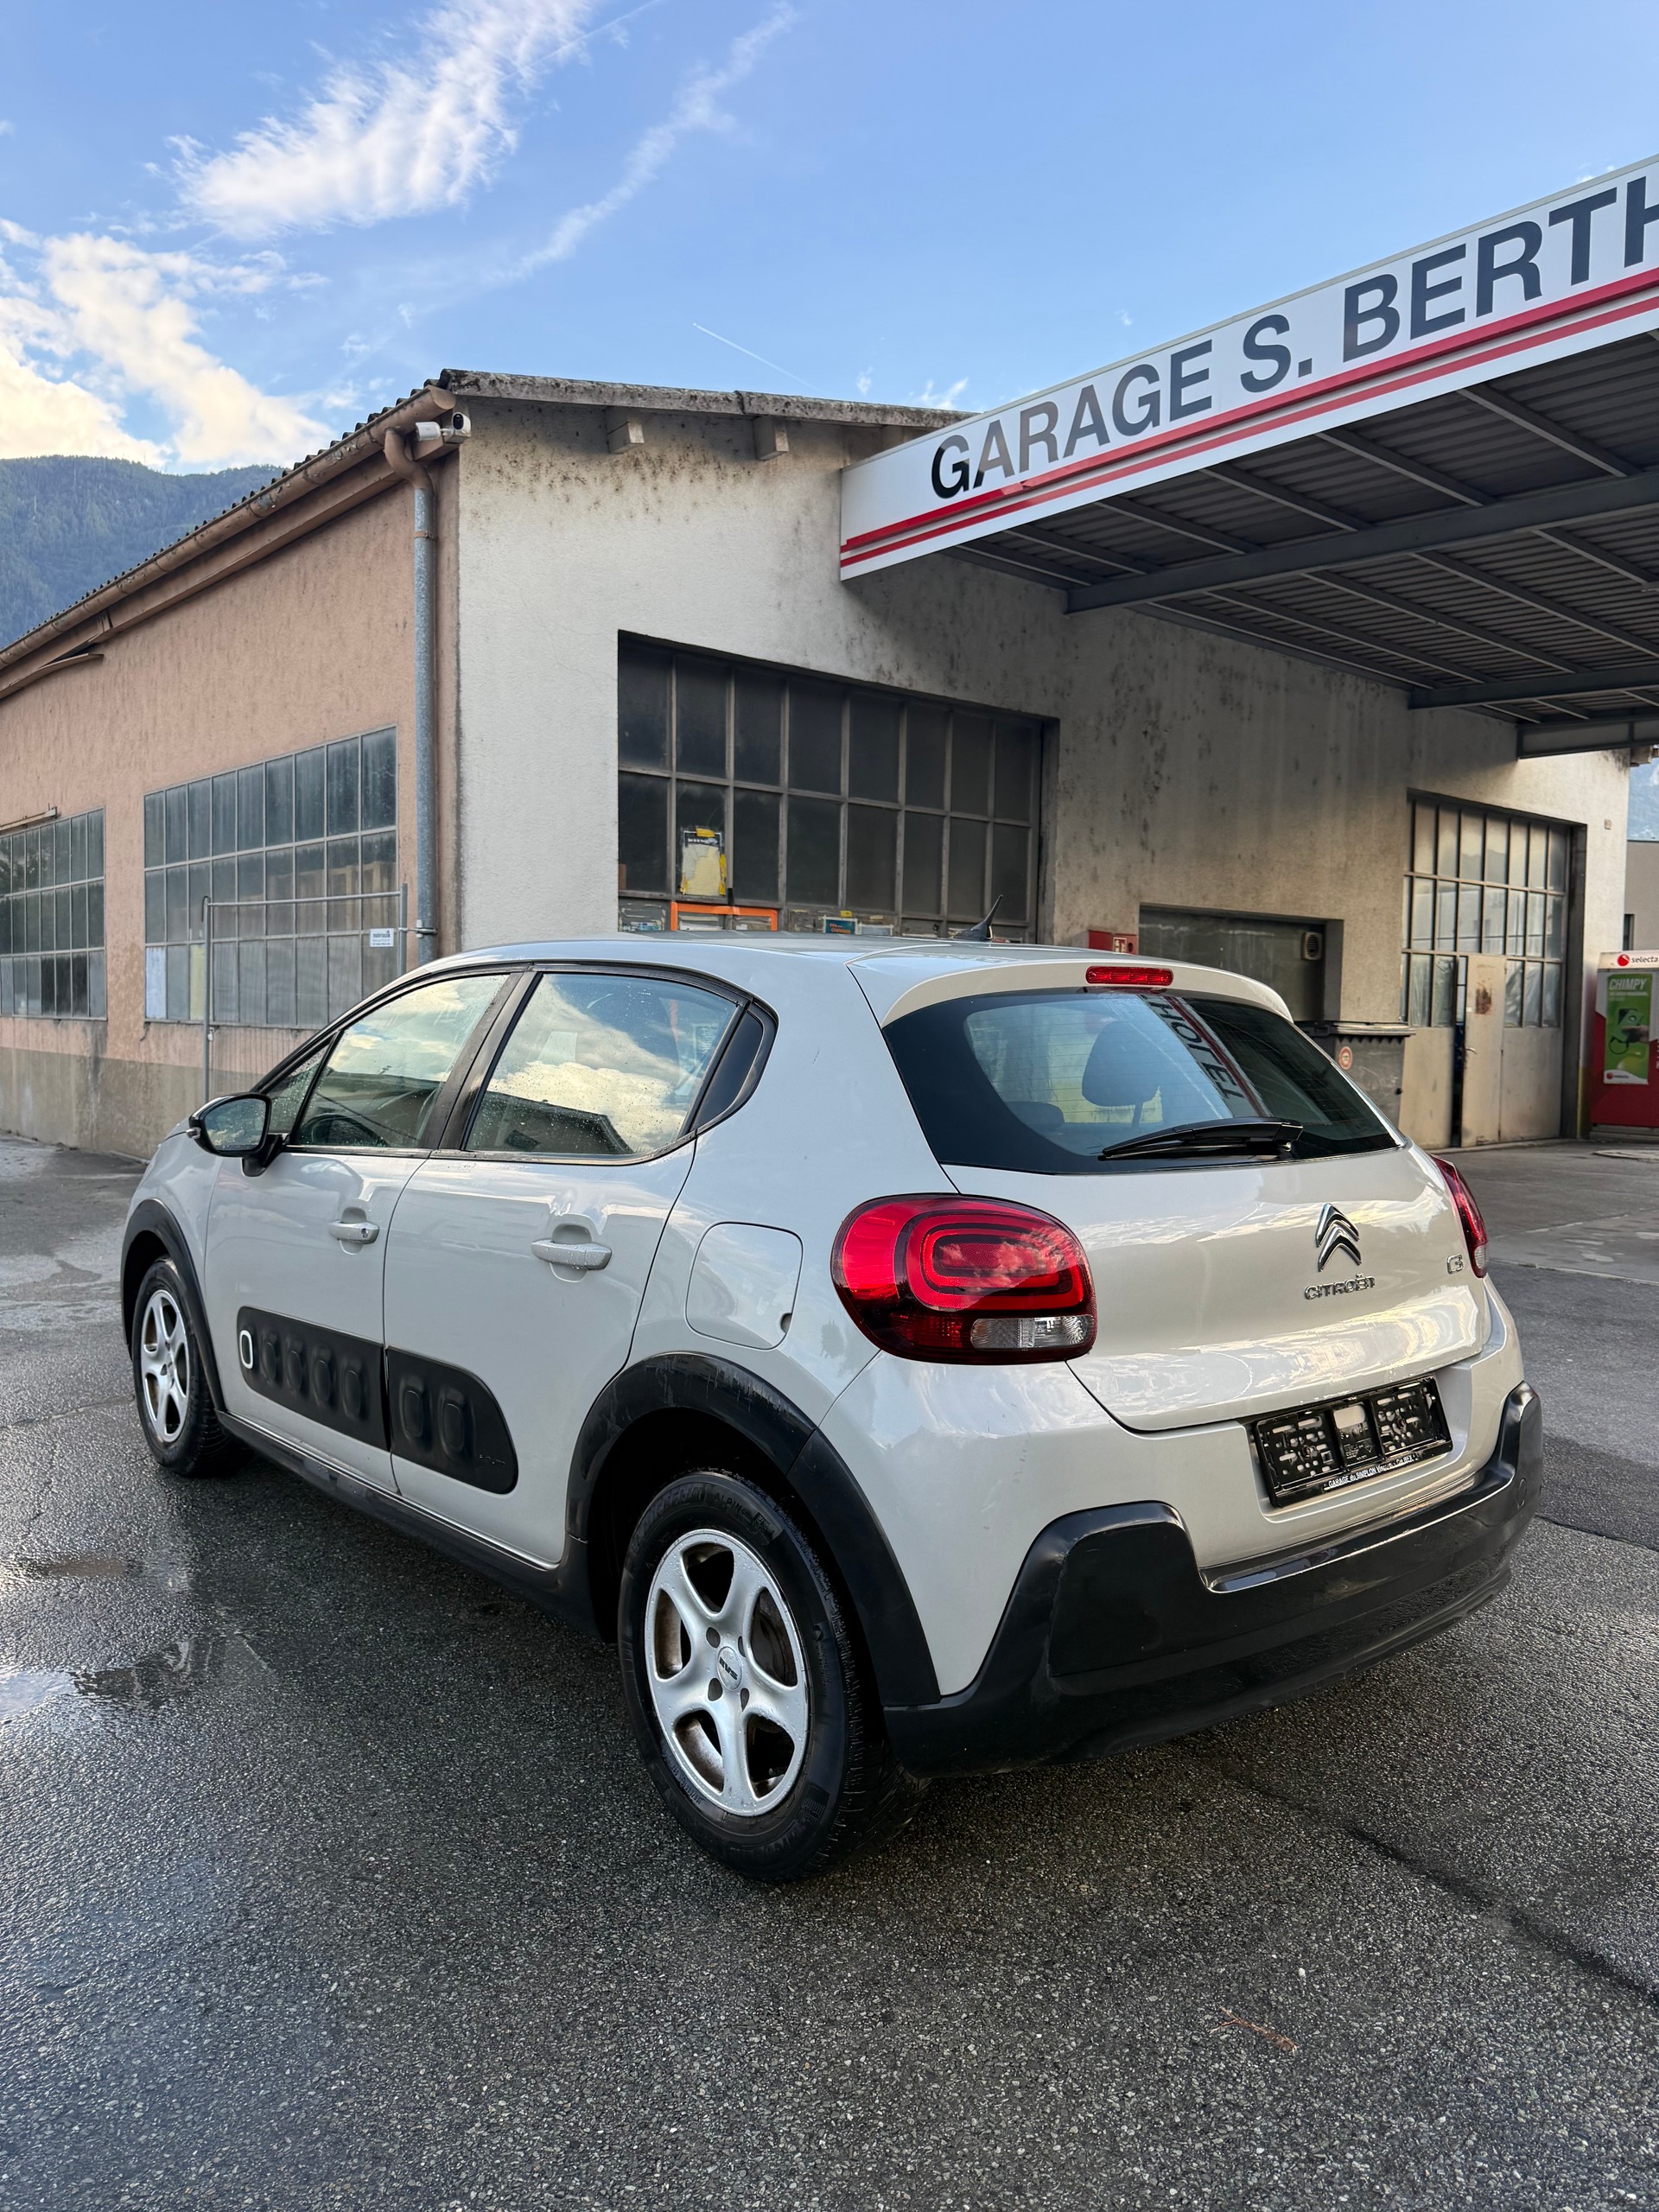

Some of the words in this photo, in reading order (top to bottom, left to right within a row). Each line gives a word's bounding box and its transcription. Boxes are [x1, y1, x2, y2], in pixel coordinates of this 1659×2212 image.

[931, 340, 1213, 499] GARAGE
[1240, 313, 1313, 394] S.
[1631, 956, 1659, 964] selecta
[1609, 978, 1647, 990] CHIMPY
[1446, 1254, 1464, 1274] C3
[1328, 1475, 1350, 1487] GARAGE
